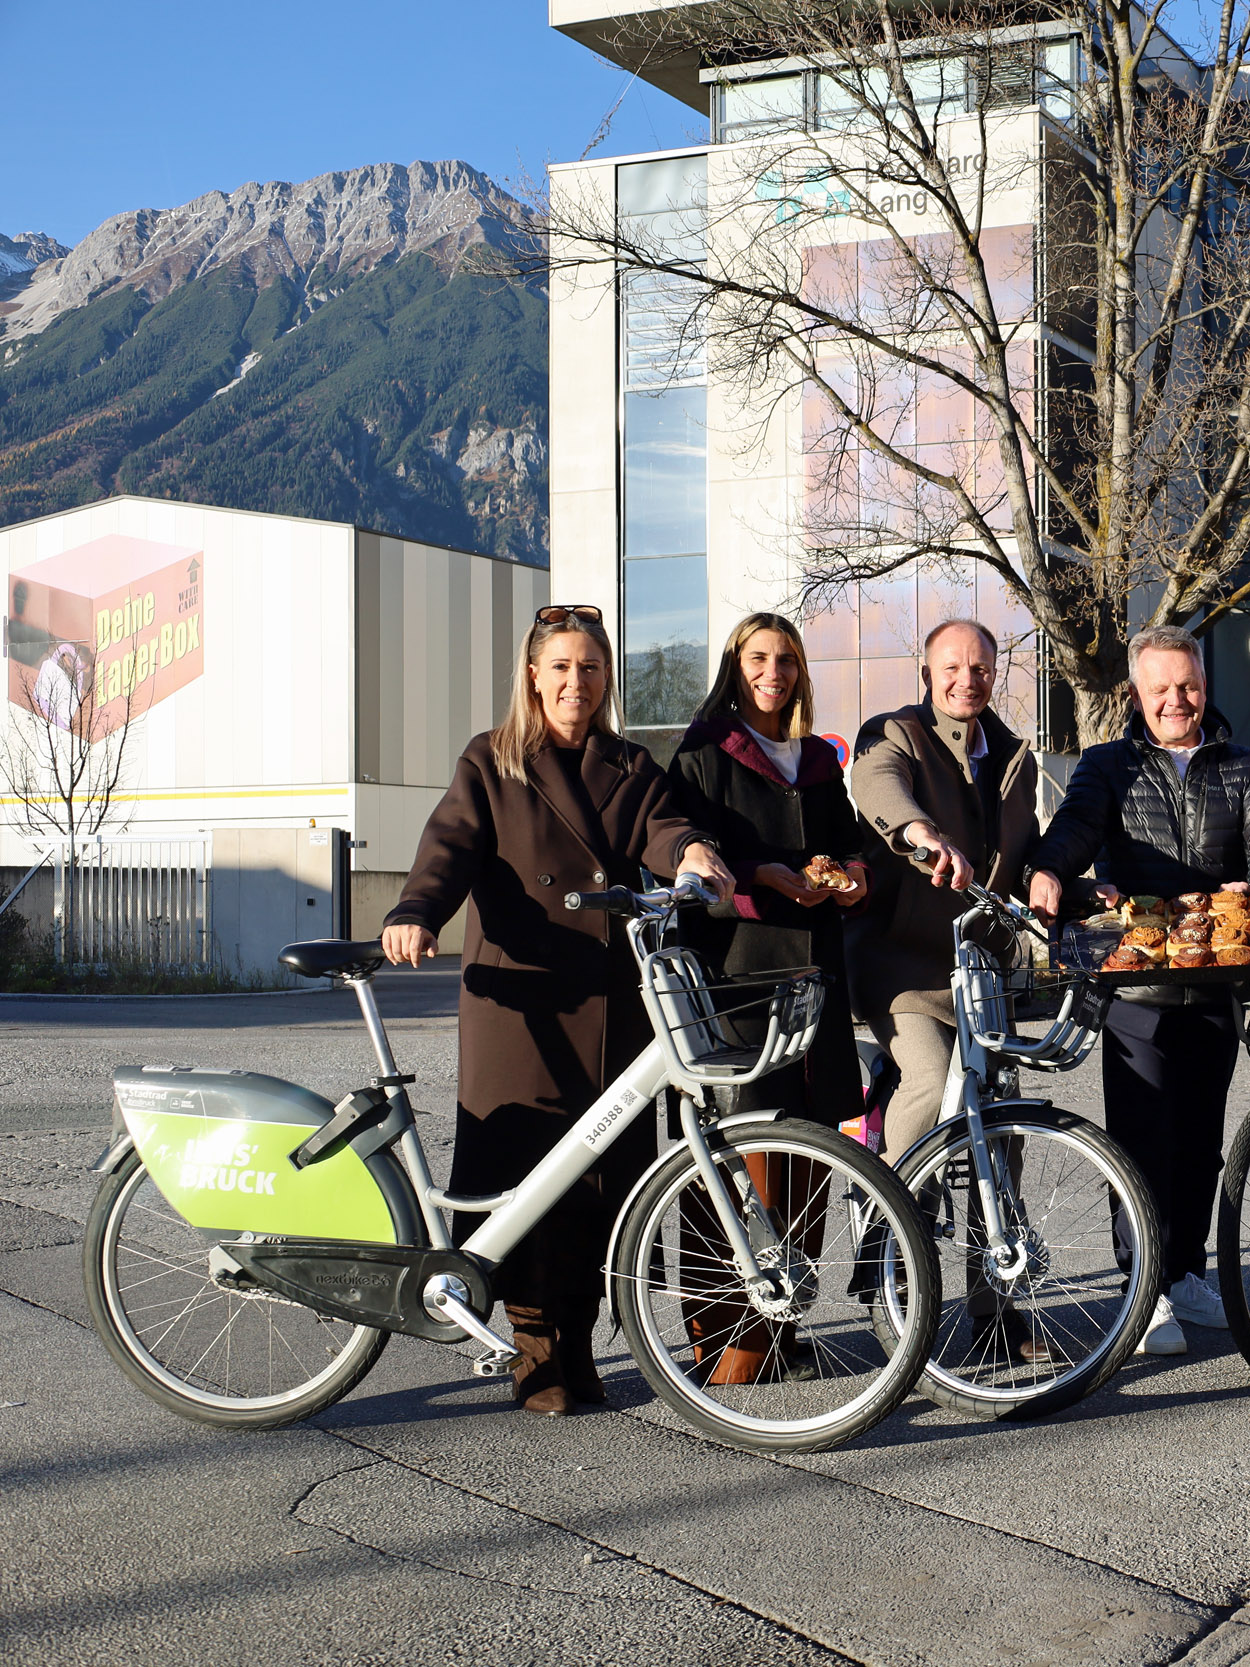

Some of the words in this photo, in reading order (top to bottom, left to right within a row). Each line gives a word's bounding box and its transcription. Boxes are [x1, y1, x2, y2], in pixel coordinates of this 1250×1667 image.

[865, 147, 987, 184] Leonard
[865, 190, 928, 216] Lang
[178, 584, 199, 602] WITH
[178, 595, 199, 614] CARE
[96, 591, 155, 654] Deine
[128, 1089, 168, 1100] Stadtrad
[585, 1104, 623, 1145] 340388
[185, 1138, 259, 1167] IS'
[179, 1164, 277, 1195] BRUCK
[315, 1273, 370, 1286] nextbike
